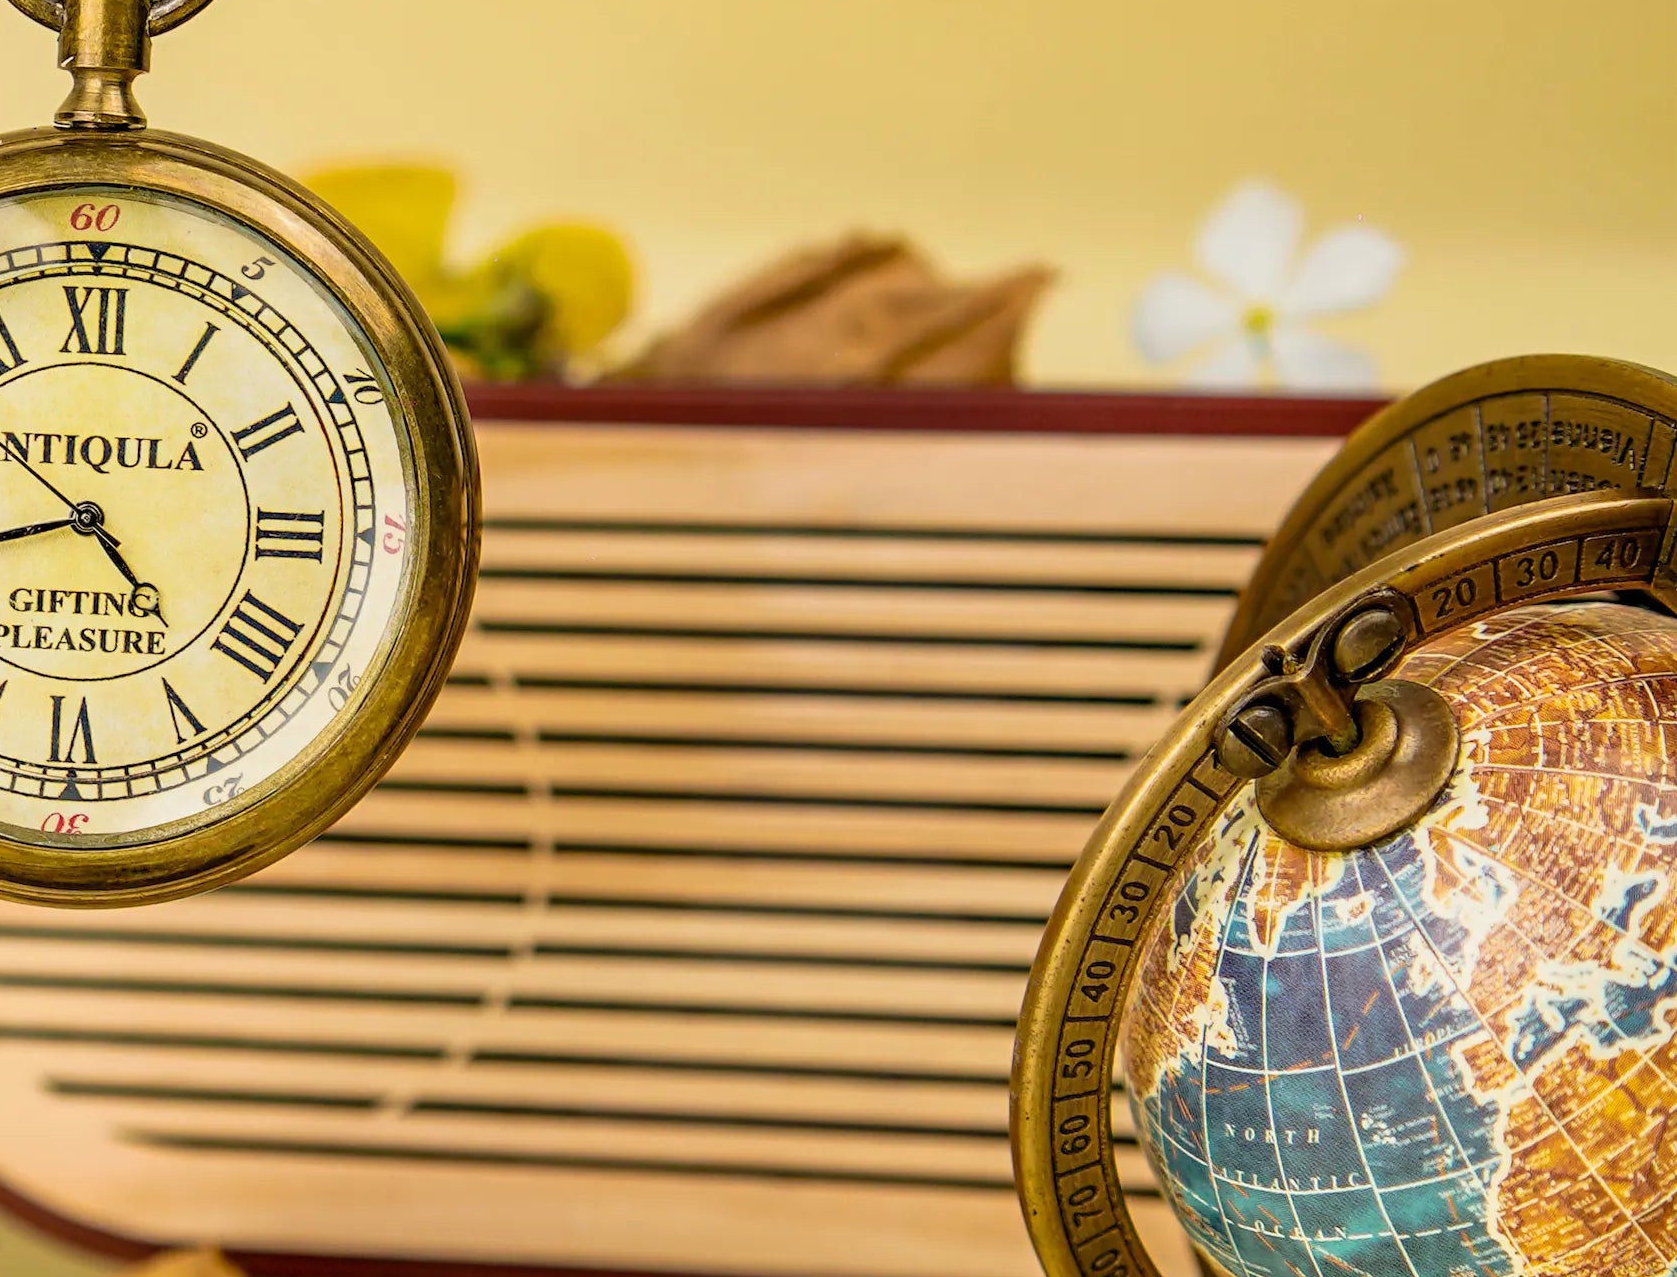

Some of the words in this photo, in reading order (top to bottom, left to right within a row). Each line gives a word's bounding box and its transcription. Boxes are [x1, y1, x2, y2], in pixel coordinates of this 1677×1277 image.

[70, 203, 122, 232] 60
[240, 255, 278, 282] 5
[60, 285, 129, 356] XII
[171, 321, 221, 385] I
[342, 367, 385, 407] 10
[229, 400, 306, 463] II
[254, 506, 325, 565] III
[382, 512, 409, 556] 15
[1432, 576, 1478, 620] 20
[1515, 550, 1561, 588] 30
[1595, 536, 1642, 570] 40
[8, 588, 158, 619] GIFTING
[210, 589, 306, 685] IIII
[46, 695, 98, 765] VI
[162, 676, 209, 745] V
[1153, 804, 1198, 852] 20
[1109, 879, 1151, 926] 30
[1080, 960, 1117, 1005] 40
[1062, 1038, 1096, 1081] 50
[1060, 1111, 1092, 1157] 60
[1224, 1122, 1321, 1145] NORTH
[1220, 1167, 1360, 1192] ATLANTIC
[1068, 1184, 1104, 1228] 70
[1254, 1219, 1347, 1240] OCEAN
